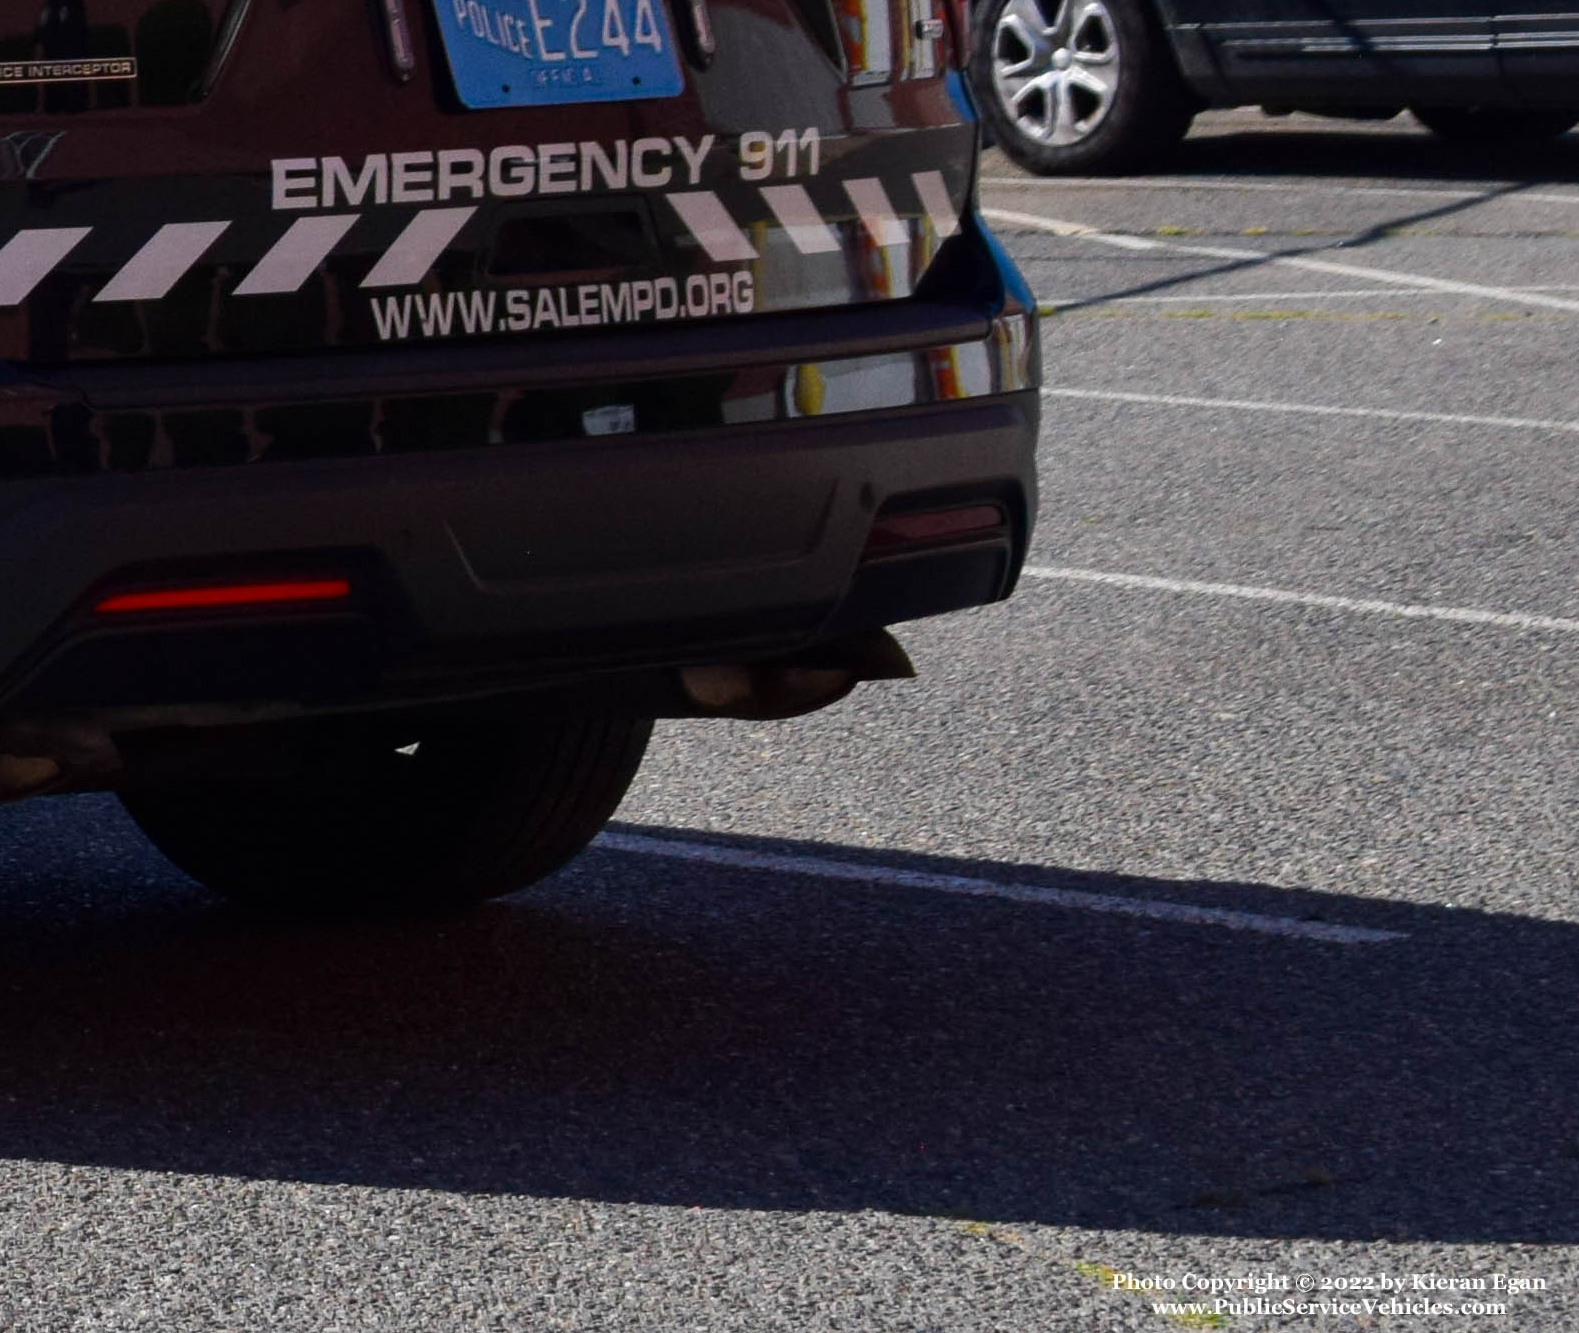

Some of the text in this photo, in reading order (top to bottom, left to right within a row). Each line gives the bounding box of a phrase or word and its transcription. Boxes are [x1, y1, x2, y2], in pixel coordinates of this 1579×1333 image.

[27, 60, 132, 79] INTERCEPTOR
[271, 126, 821, 210] EMERGENCY 911
[370, 270, 755, 341] WWW.SALEMPD.ORG
